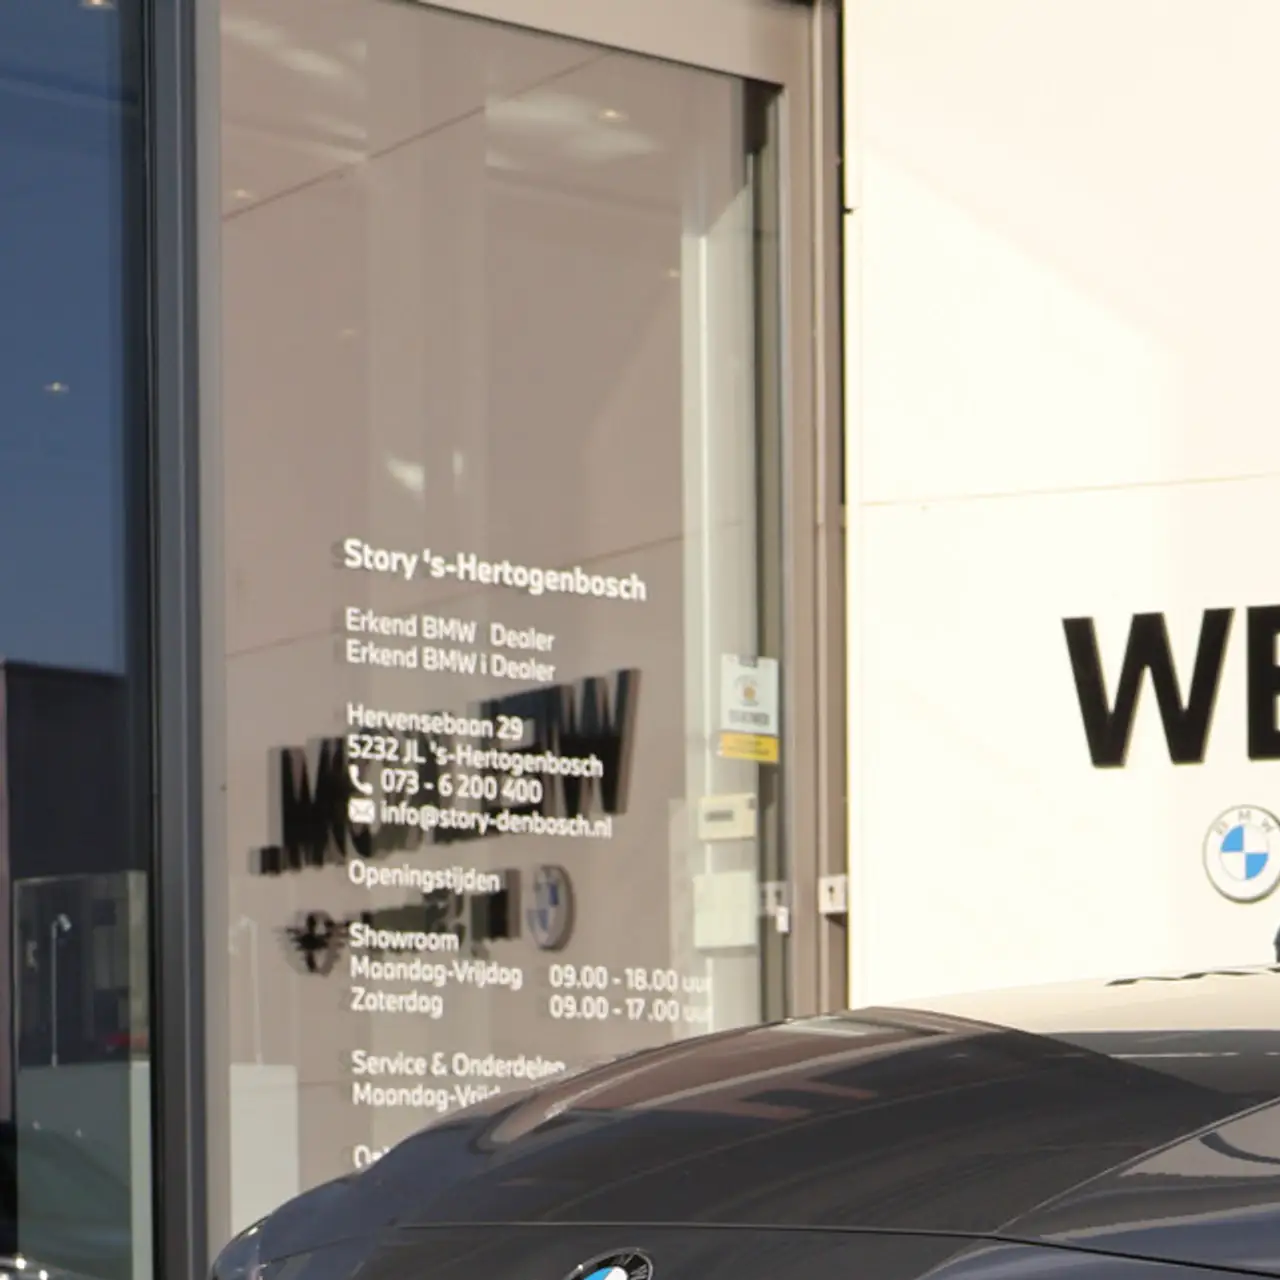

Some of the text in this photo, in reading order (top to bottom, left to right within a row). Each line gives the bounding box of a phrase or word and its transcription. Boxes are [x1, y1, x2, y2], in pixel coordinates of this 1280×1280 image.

[343, 537, 647, 601] Story 's-Hertogenbosch
[345, 606, 556, 652] Erkend BMW Dealer
[345, 638, 556, 682] Erkend BMW i Dealer
[346, 703, 524, 741] Hervensebaan 29
[347, 734, 604, 778] 5232 JL 's-Hertogenbosch
[380, 768, 420, 795] 073
[438, 773, 453, 798] 6
[457, 774, 498, 801] 200
[501, 778, 544, 804] 400
[380, 800, 613, 840] info@story-denbosch.nl
[348, 861, 501, 893] Openingstijden
[350, 922, 460, 952] Showroom
[350, 955, 523, 990] Maandag-Vrijdag
[549, 964, 608, 991] 09.00
[625, 968, 678, 993] 18.00
[350, 987, 444, 1018] Zaterdag
[549, 995, 609, 1019] 09.00
[625, 998, 680, 1022] 17.00
[351, 1050, 427, 1076] Service
[431, 1052, 448, 1077] &
